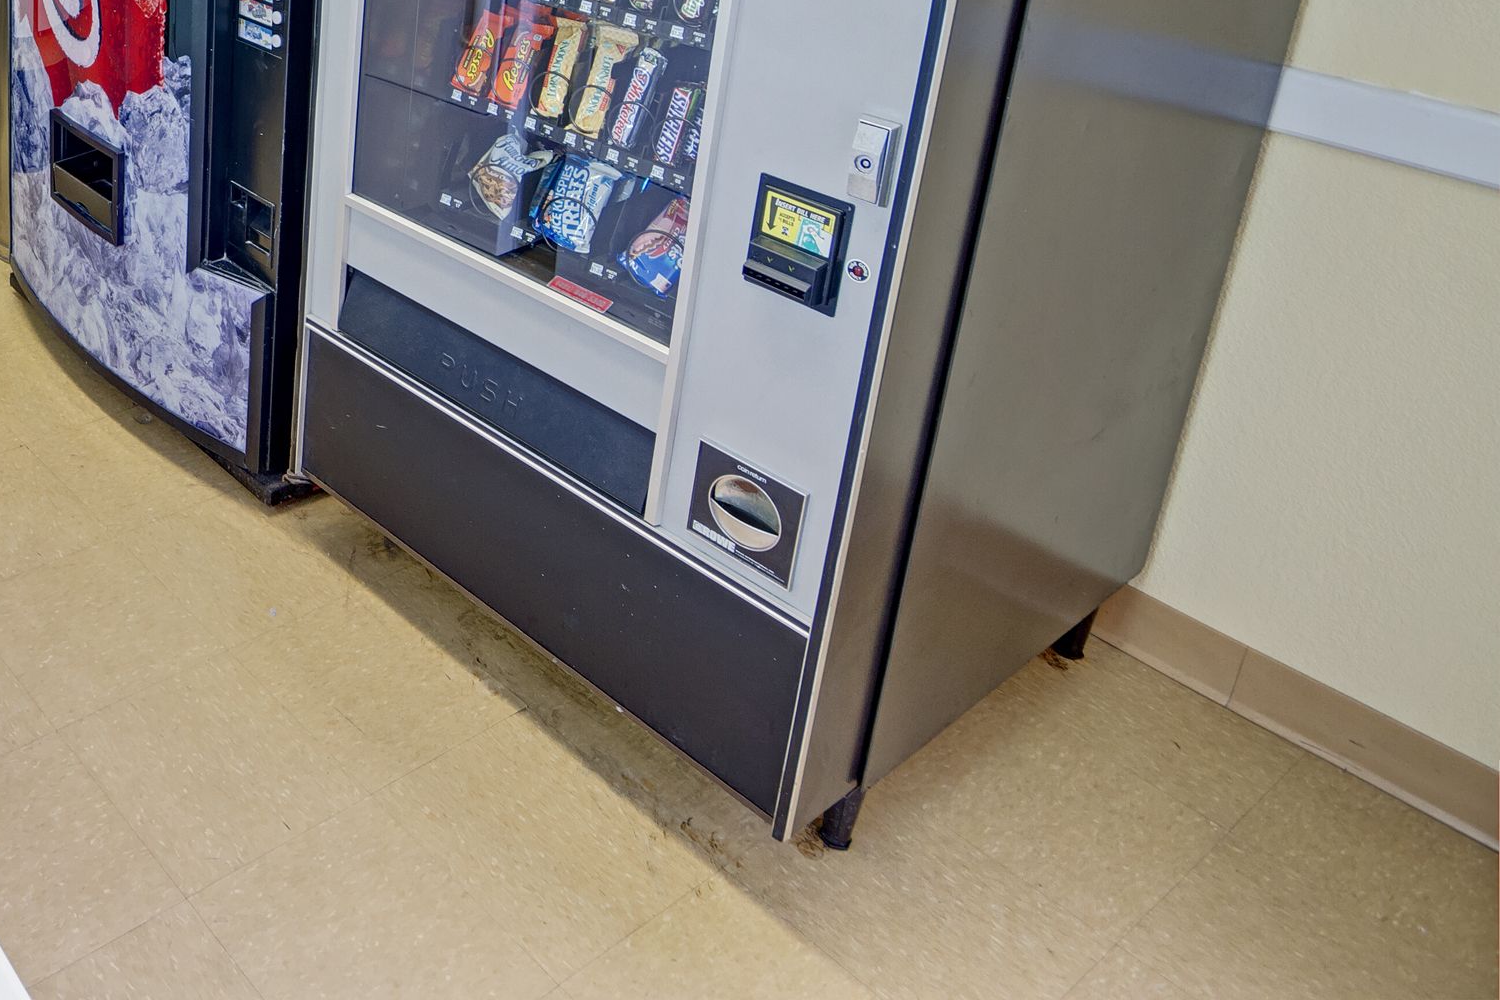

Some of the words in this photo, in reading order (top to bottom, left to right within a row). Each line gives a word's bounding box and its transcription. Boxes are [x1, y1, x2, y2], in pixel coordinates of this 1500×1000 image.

[468, 28, 494, 80] Reese's
[503, 39, 530, 92] Reese's
[655, 92, 688, 164] SNICKERS
[562, 168, 590, 239] TREATS
[587, 183, 600, 213] riginal
[775, 198, 797, 213] INSERT
[797, 208, 810, 218] BILL
[810, 212, 825, 224] HERE
[779, 212, 796, 222] ACCEPTS
[441, 352, 524, 416] PUSH
[737, 464, 750, 476] coin
[750, 470, 767, 484] return
